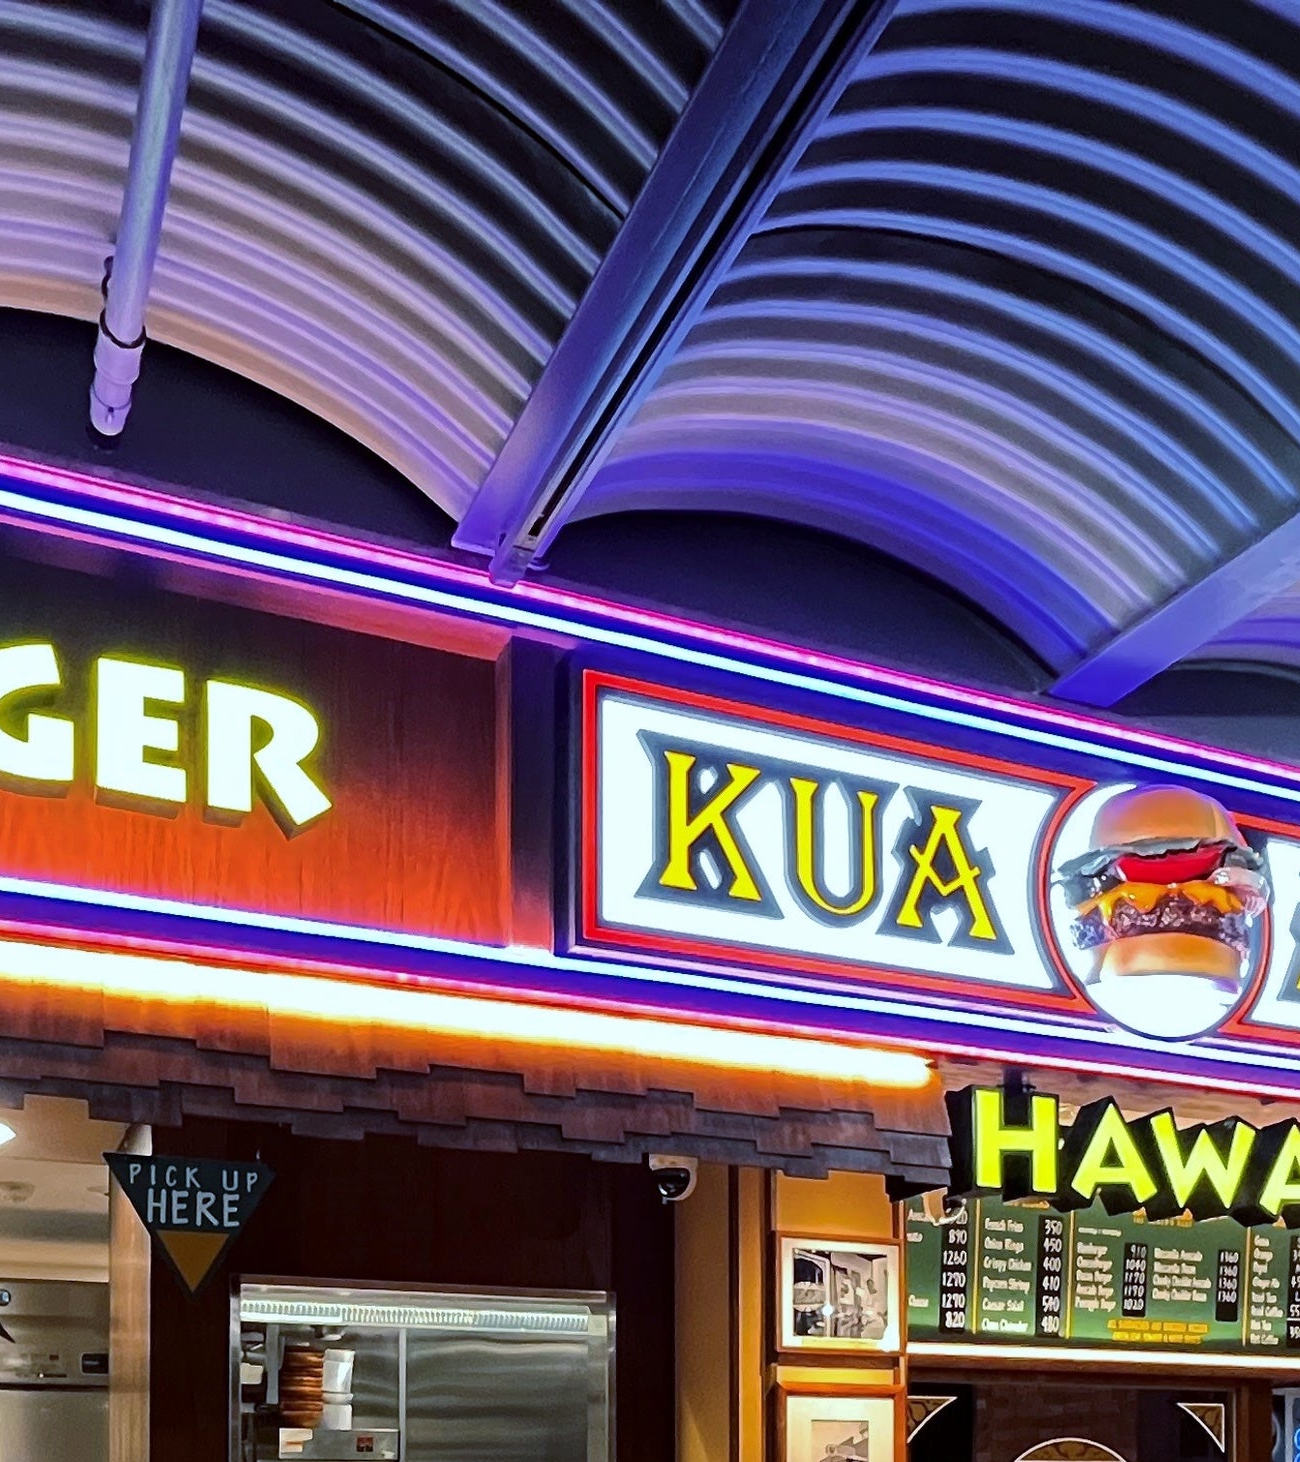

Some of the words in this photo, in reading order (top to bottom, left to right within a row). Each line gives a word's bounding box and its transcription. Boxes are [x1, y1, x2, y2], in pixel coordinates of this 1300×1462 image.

[650, 742, 1005, 946] KUA
[129, 1163, 201, 1189] PICK
[222, 1169, 258, 1193] UP
[146, 1188, 240, 1227] HERE
[1043, 1256, 1061, 1272] 400
[1042, 1275, 1060, 1291] 410
